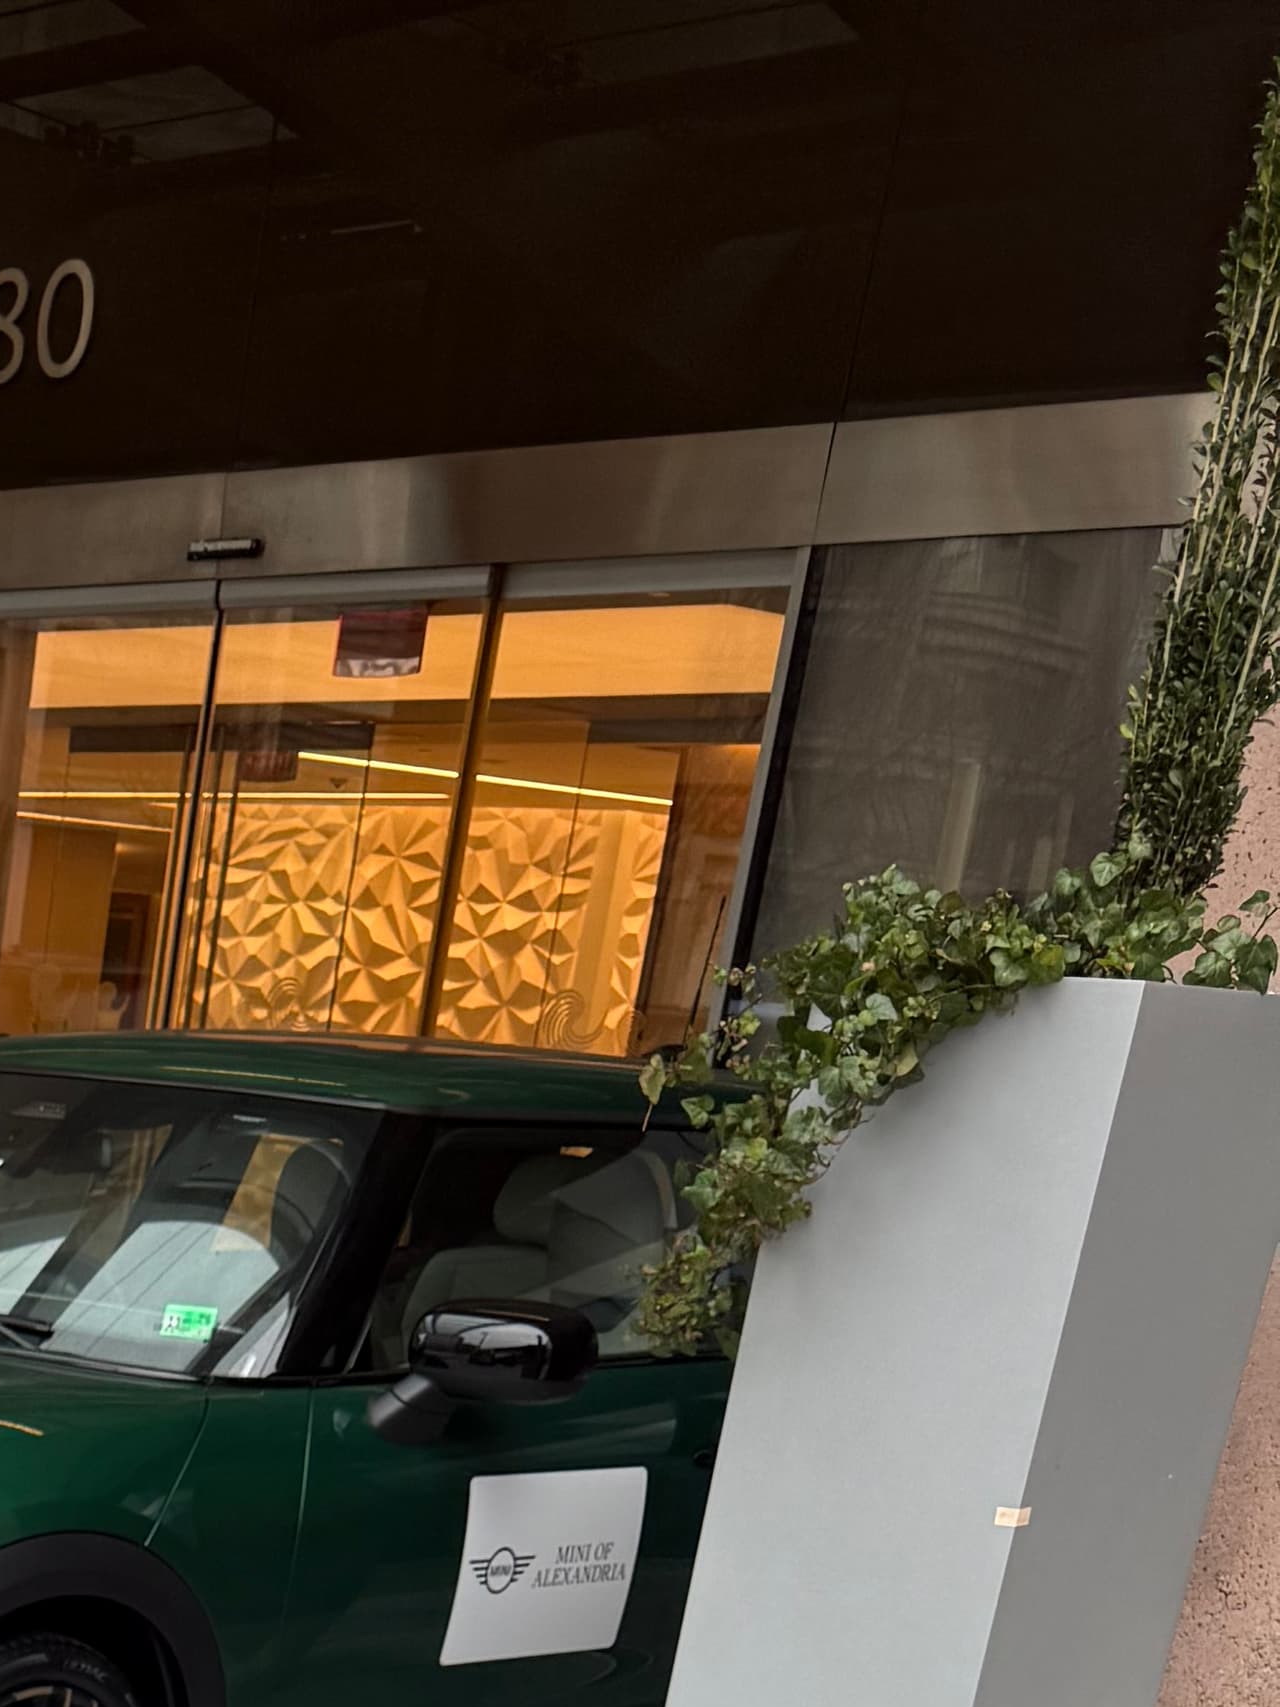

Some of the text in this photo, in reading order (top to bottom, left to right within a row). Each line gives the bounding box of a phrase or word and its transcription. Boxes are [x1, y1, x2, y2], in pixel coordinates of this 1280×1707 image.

[555, 1542, 614, 1564] MINI OF
[531, 1563, 626, 1588] ALEXANDRIA
